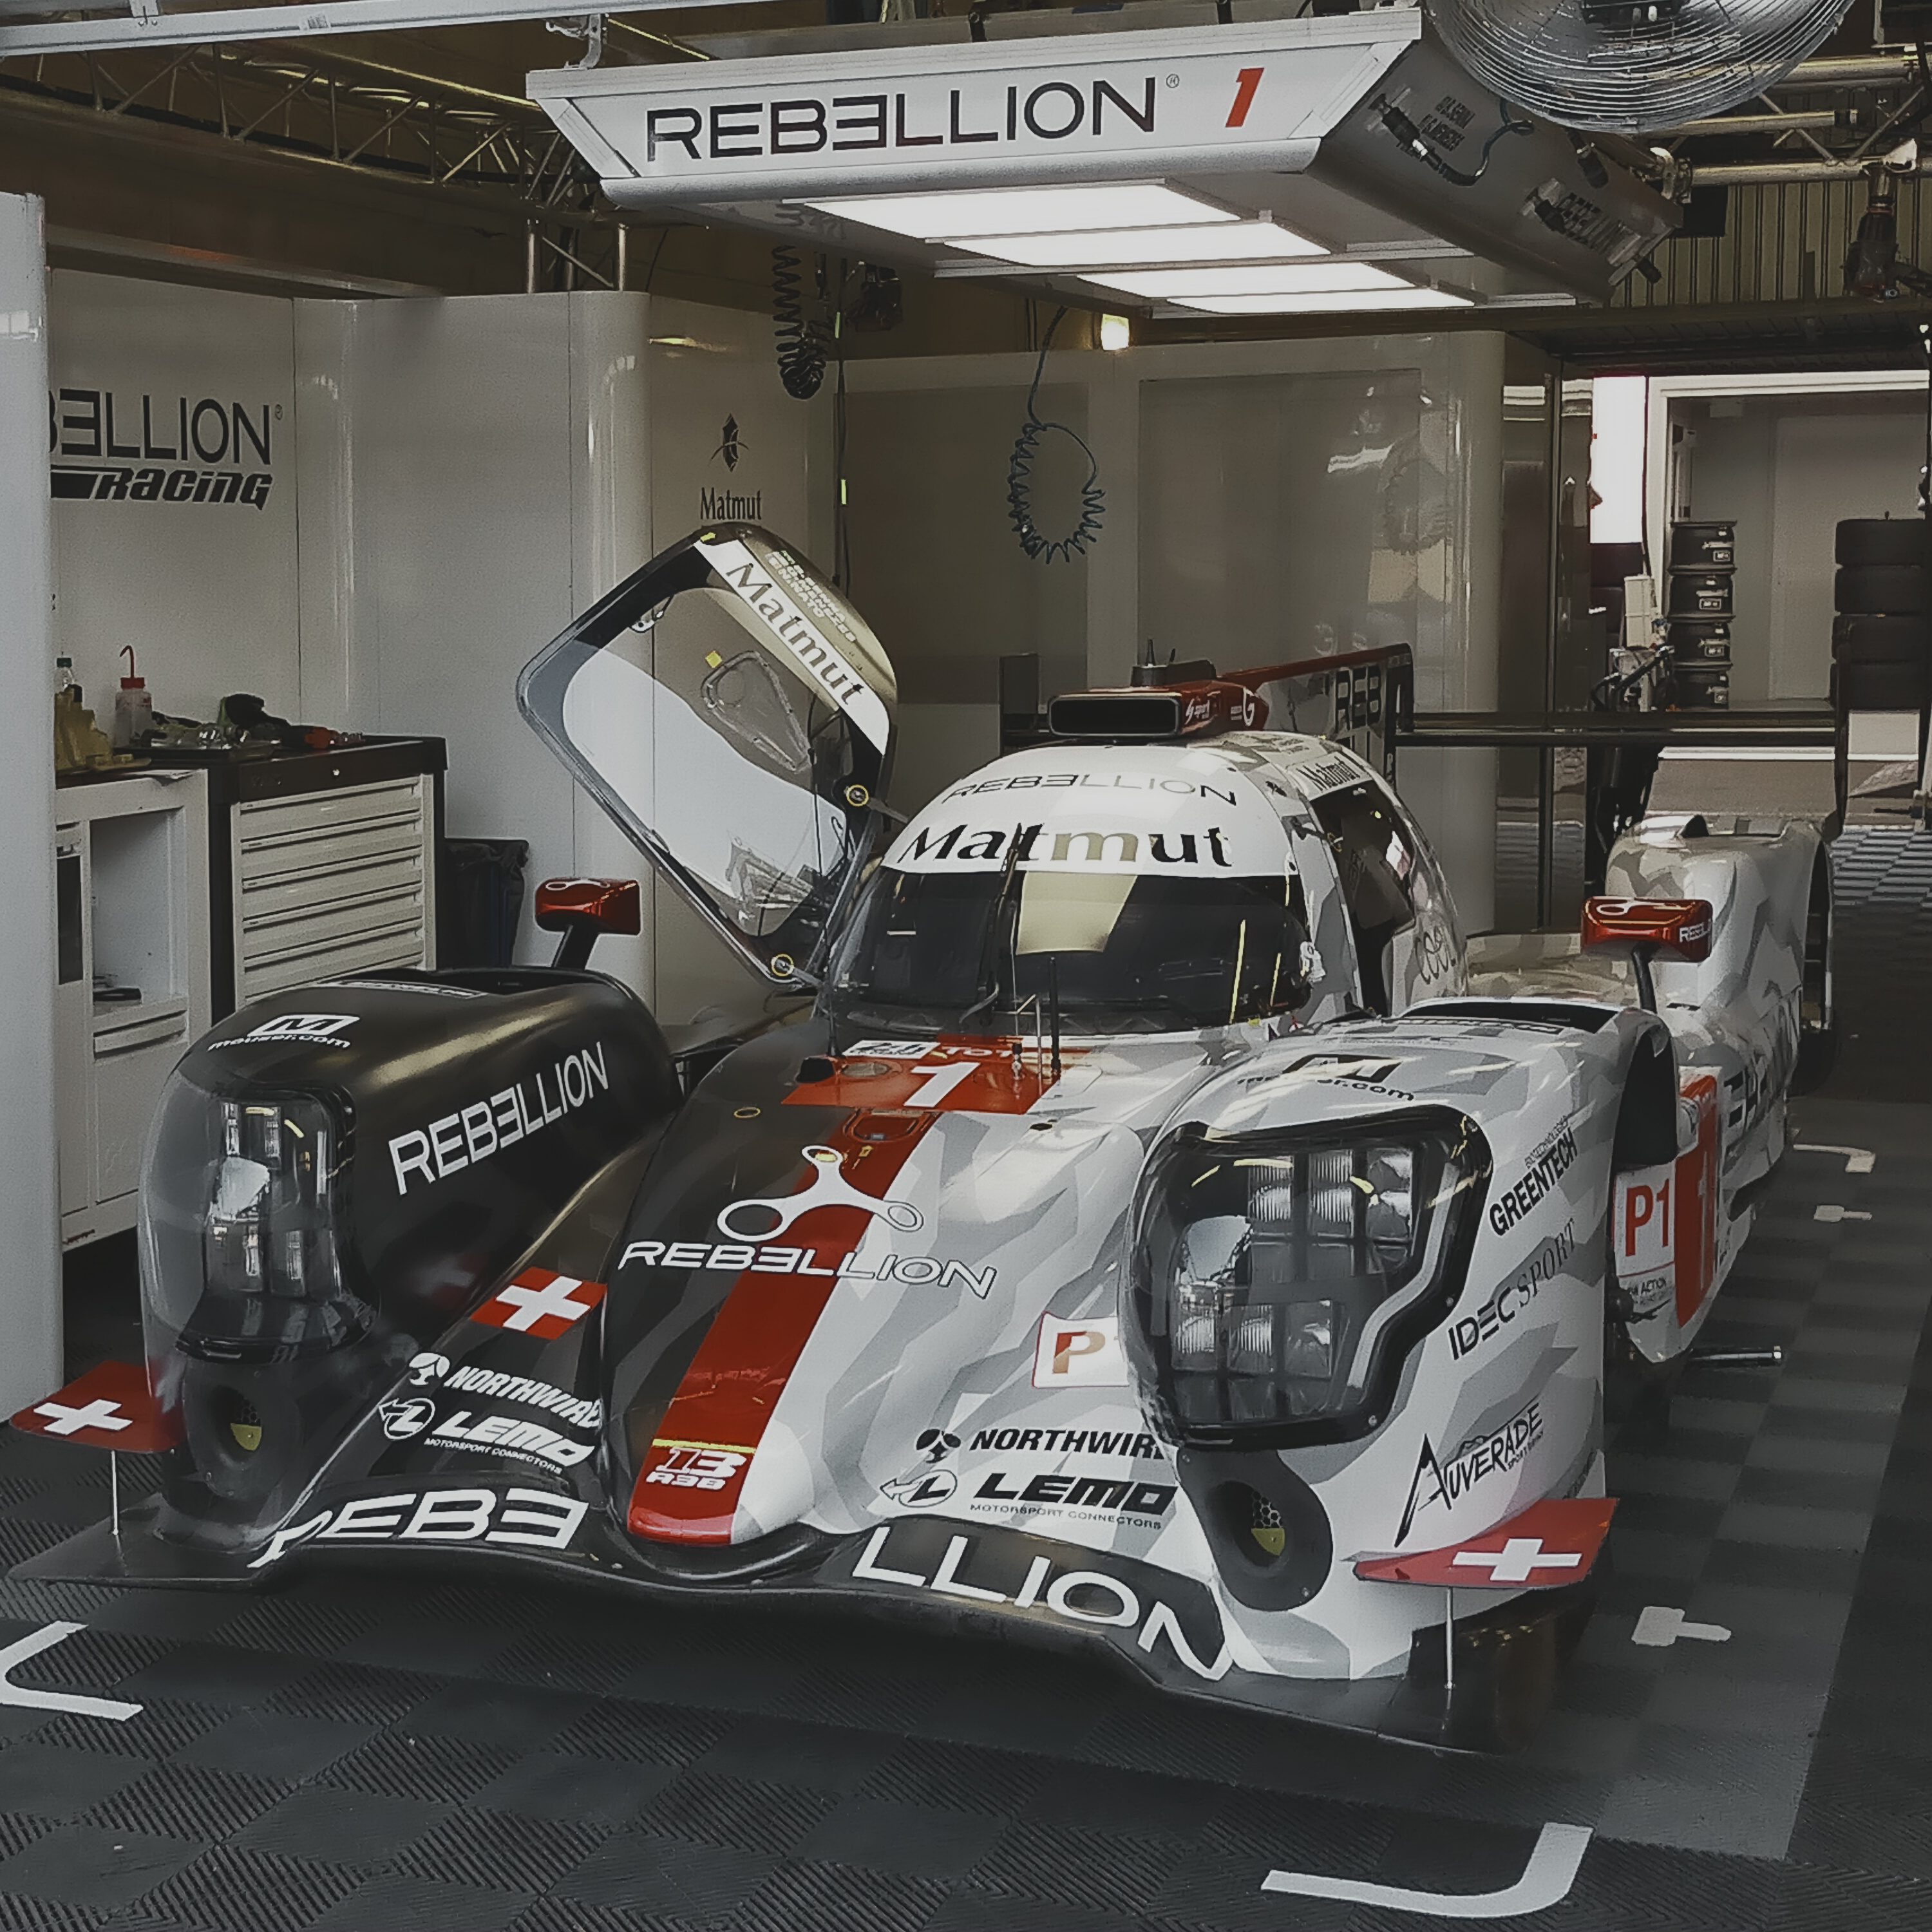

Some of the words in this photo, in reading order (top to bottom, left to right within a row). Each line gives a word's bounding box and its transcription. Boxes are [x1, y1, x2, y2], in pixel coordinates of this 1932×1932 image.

[647, 77, 1155, 162] REBELLION
[1226, 67, 1264, 128] 1
[701, 487, 762, 520] Matmut
[726, 562, 864, 705] Matmut
[941, 774, 1236, 806] REBELLION
[1295, 755, 1361, 792] Matmut
[897, 823, 1234, 867] Matmut
[904, 1062, 981, 1108] 1
[388, 1041, 609, 1195] REBELLION
[1489, 1127, 1578, 1236] GREENTECH
[1625, 1179, 1670, 1257] P1
[618, 1240, 997, 1300] REBELLION
[1448, 1287, 1515, 1360] IDEC
[1517, 1217, 1575, 1308] SPORT
[443, 1366, 603, 1428] NORTHWIRE
[424, 1437, 490, 1455] MOTORSPORT
[491, 1448, 562, 1475] CONNECTORS
[432, 1410, 595, 1467] LEMO
[970, 1504, 1064, 1517] MOTORSPORT
[1068, 1510, 1162, 1530] CONNECTORS
[973, 1473, 1179, 1516] LEMO
[852, 1526, 1233, 1681] LLION
